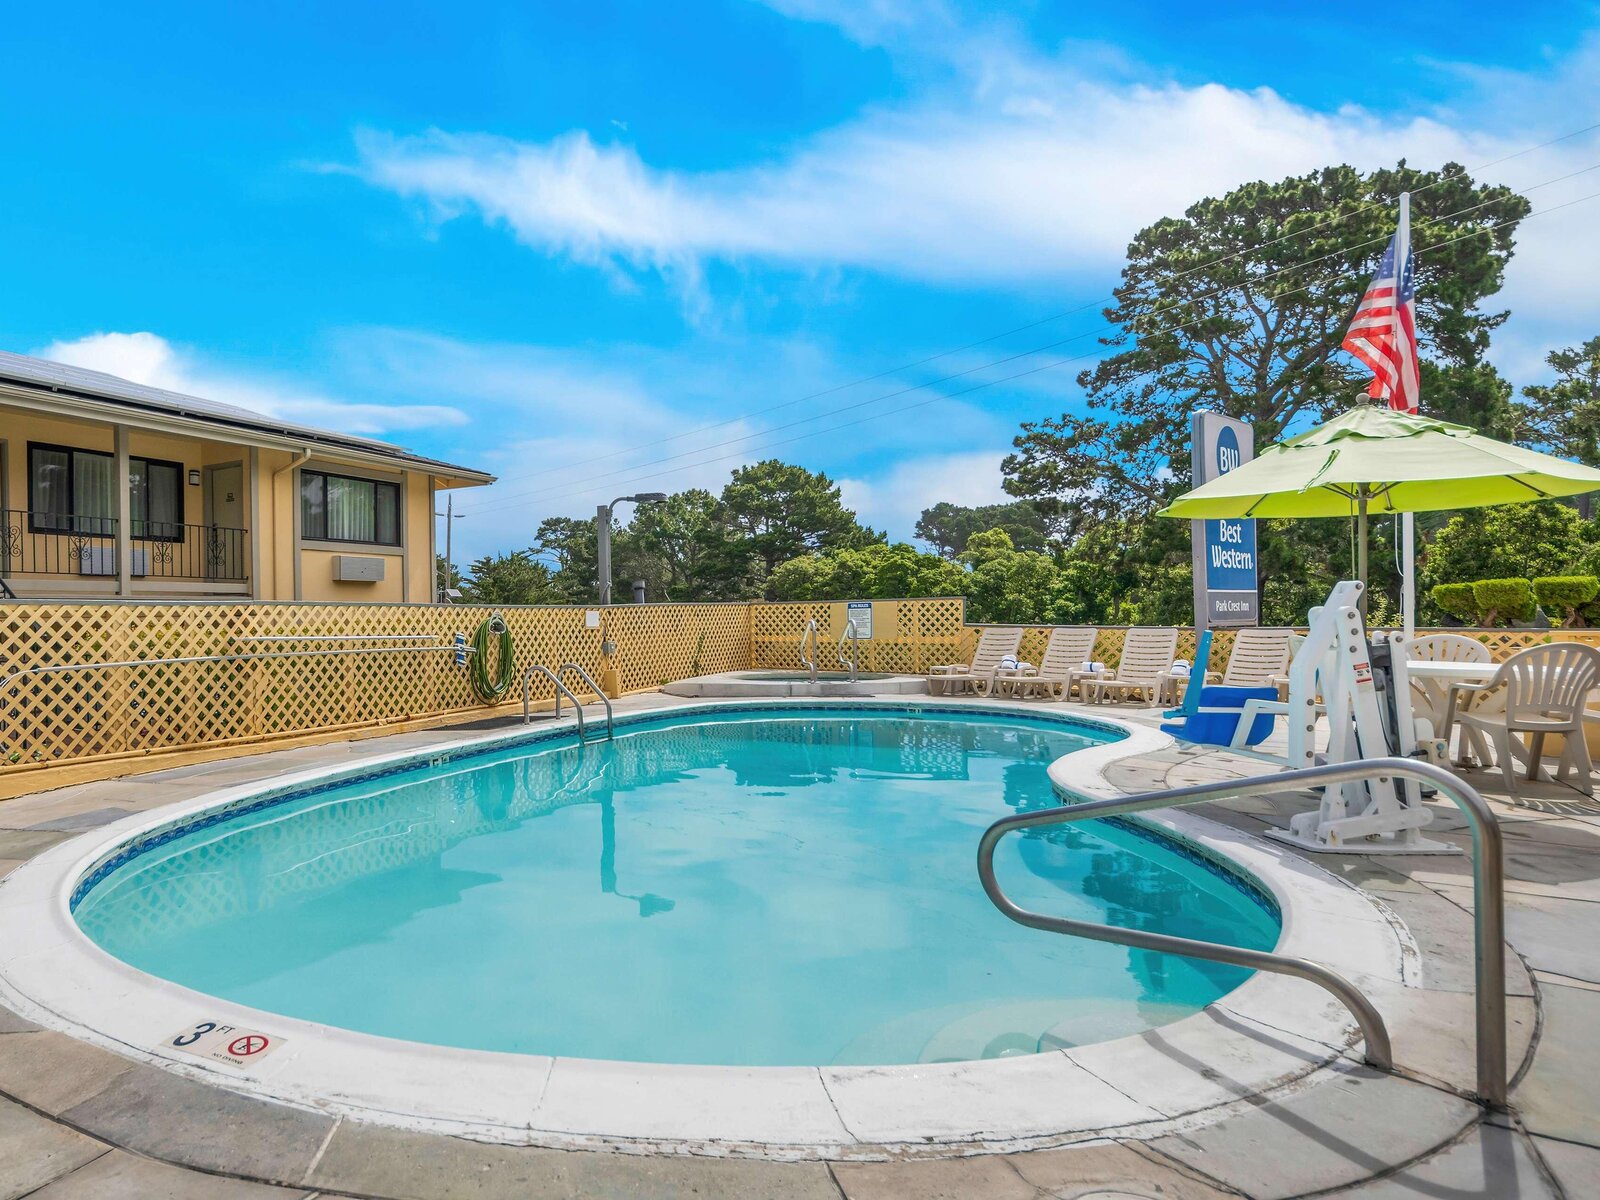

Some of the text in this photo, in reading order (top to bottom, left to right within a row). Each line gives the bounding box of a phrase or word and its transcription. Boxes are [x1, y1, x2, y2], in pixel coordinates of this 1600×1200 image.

[1220, 446, 1238, 471] BW
[1220, 519, 1242, 544] Best
[1211, 545, 1253, 570] Western
[1216, 600, 1250, 612] Park Crest Inn
[173, 1022, 236, 1047] 3 FT
